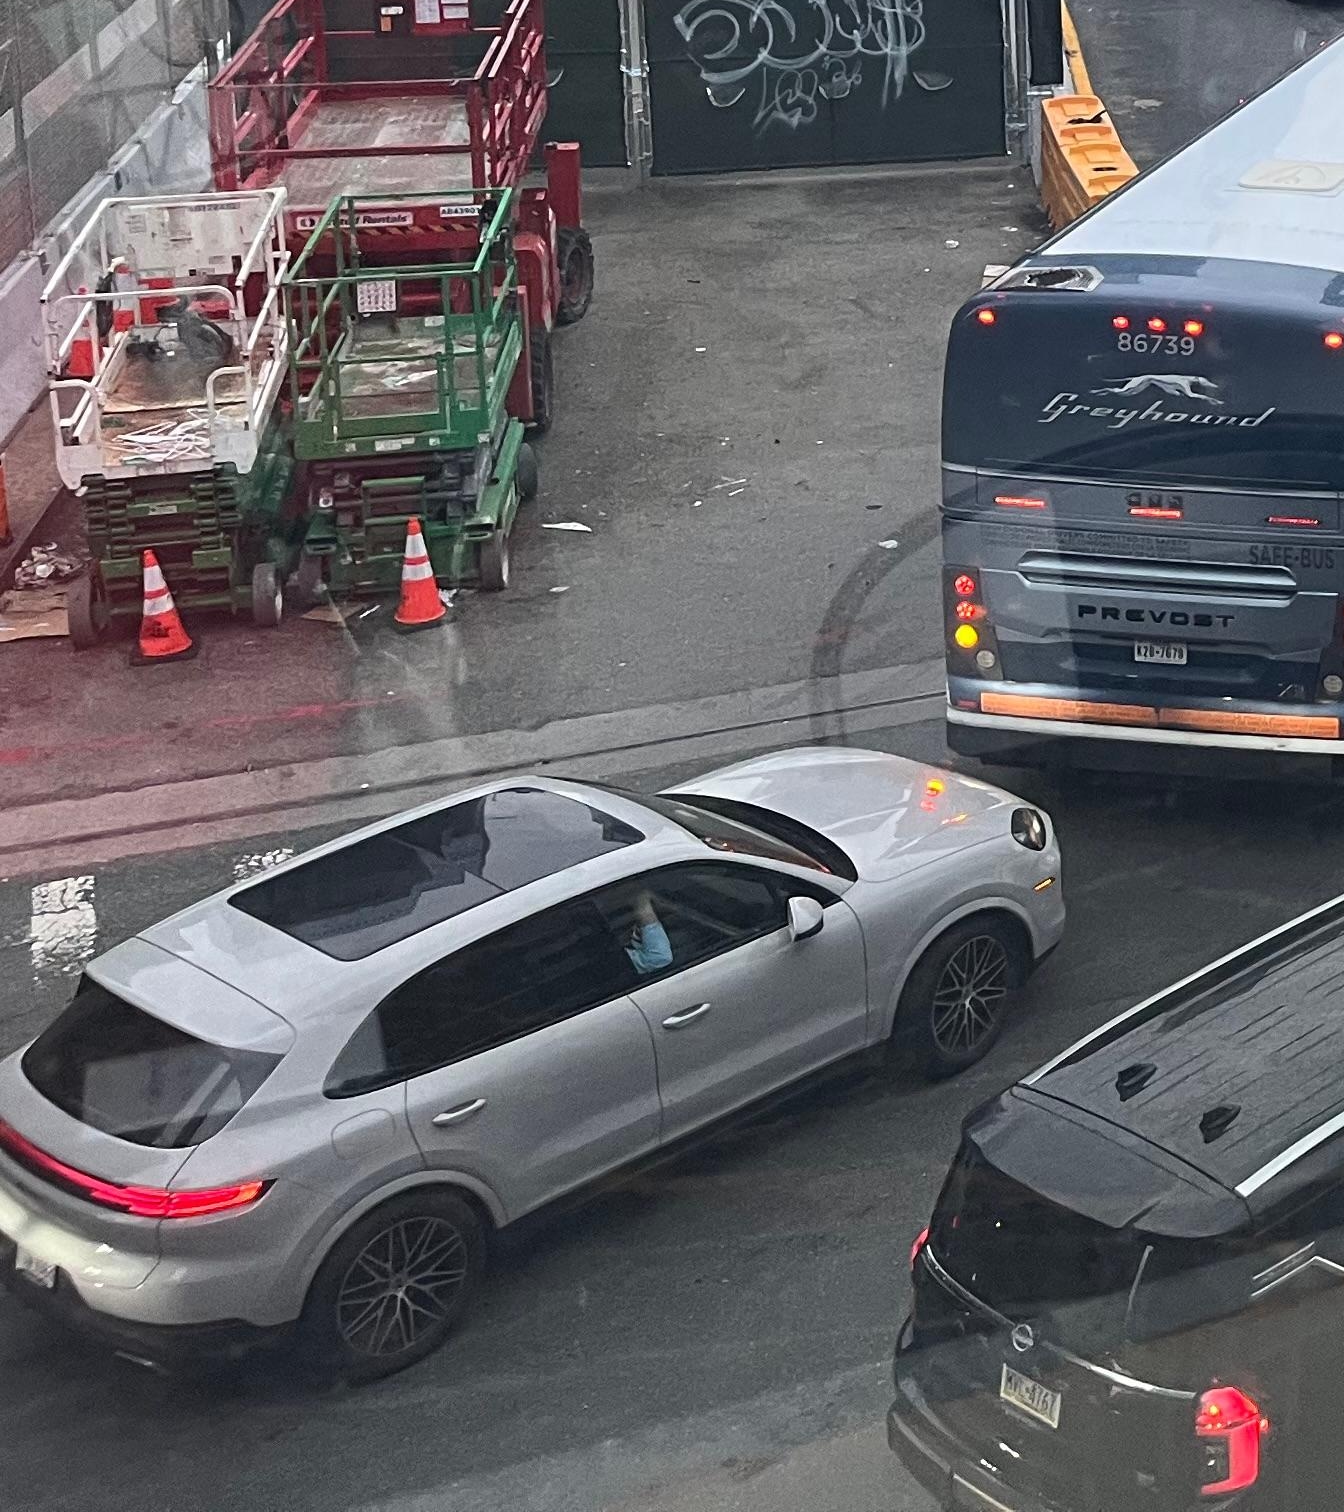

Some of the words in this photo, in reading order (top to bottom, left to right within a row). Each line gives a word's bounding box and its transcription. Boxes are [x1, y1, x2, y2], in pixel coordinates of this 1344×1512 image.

[362, 214, 408, 225] Rentals
[1117, 332, 1195, 355] 86739
[1037, 392, 1276, 429] Greyhound
[1249, 544, 1336, 569] SAFE-BUS
[1078, 604, 1235, 628] PREVOST
